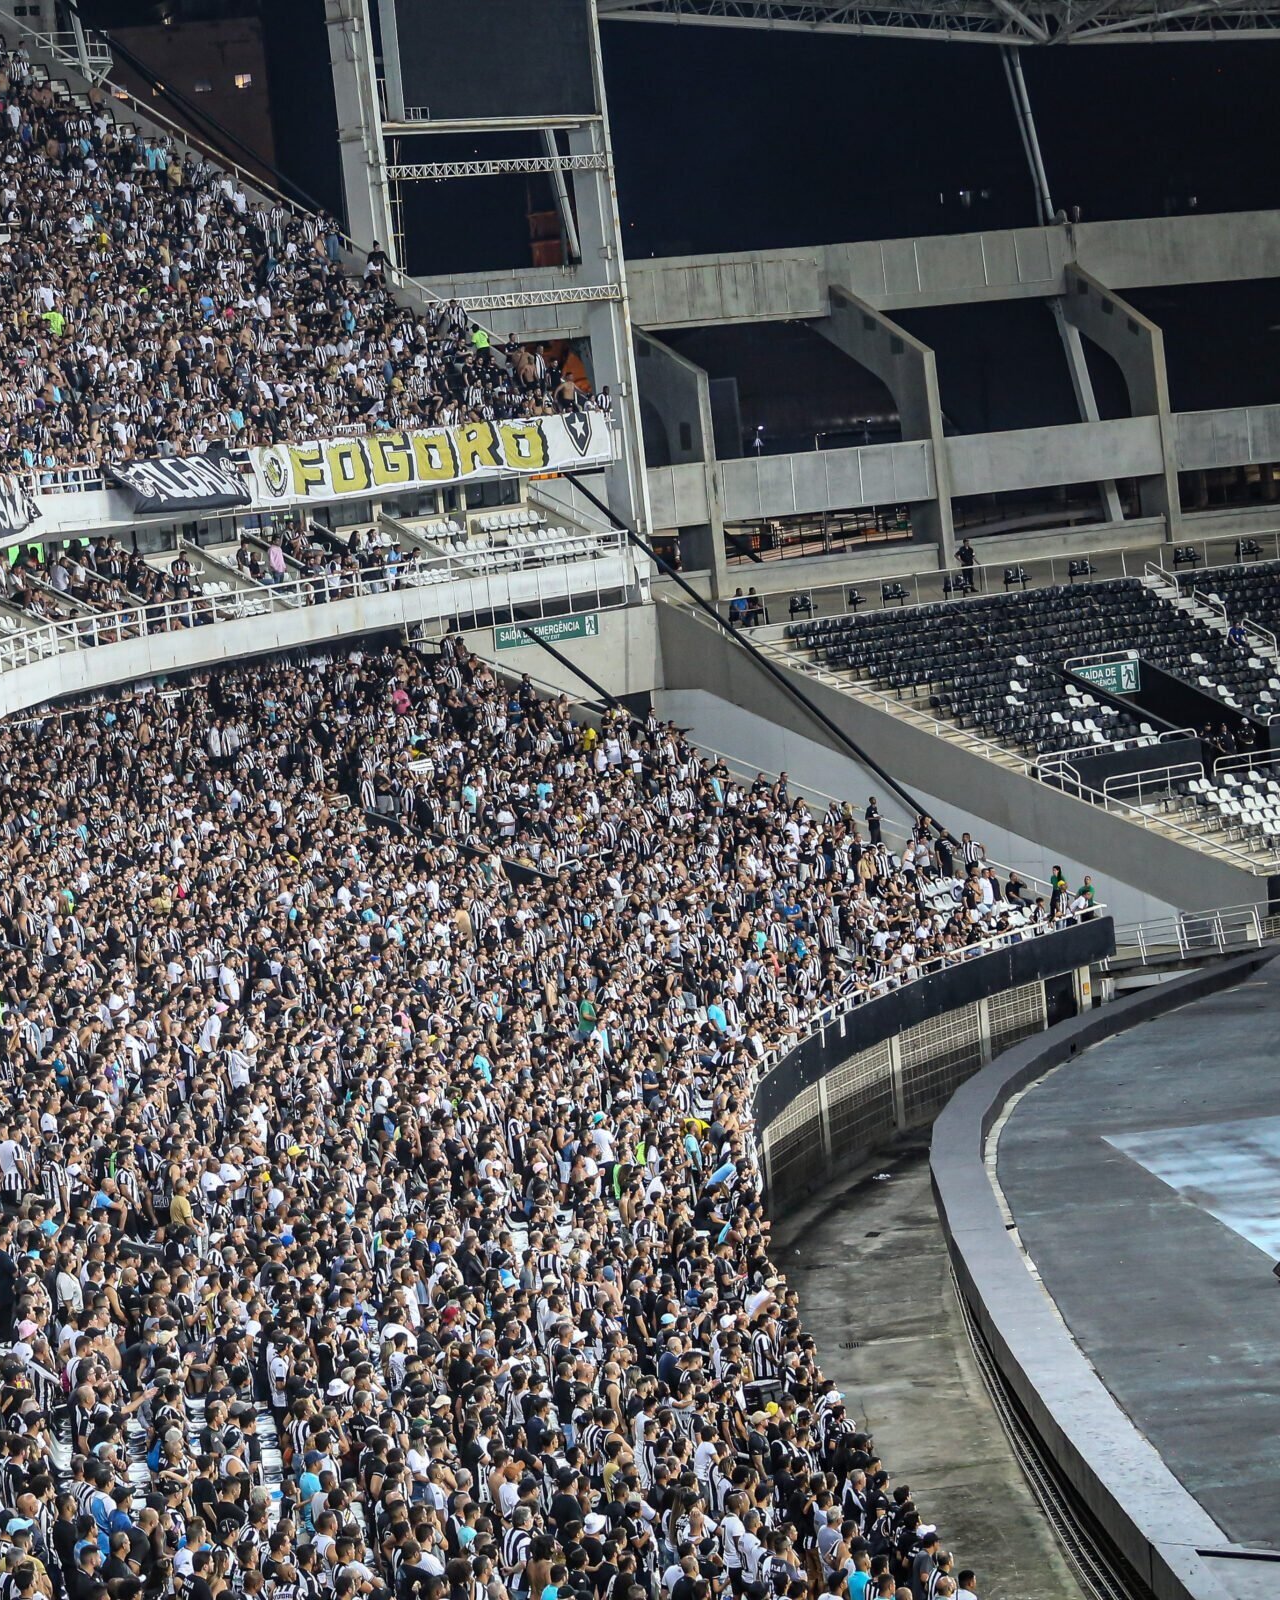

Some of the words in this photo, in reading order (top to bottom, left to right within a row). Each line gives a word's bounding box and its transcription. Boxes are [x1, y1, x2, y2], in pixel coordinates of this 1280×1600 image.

[288, 419, 549, 496] FOGORO
[500, 628, 522, 641] SAÍDA
[534, 620, 580, 636] EMERGÊNCIA
[1080, 669, 1103, 680] SAÍDA
[1105, 667, 1116, 677] DE
